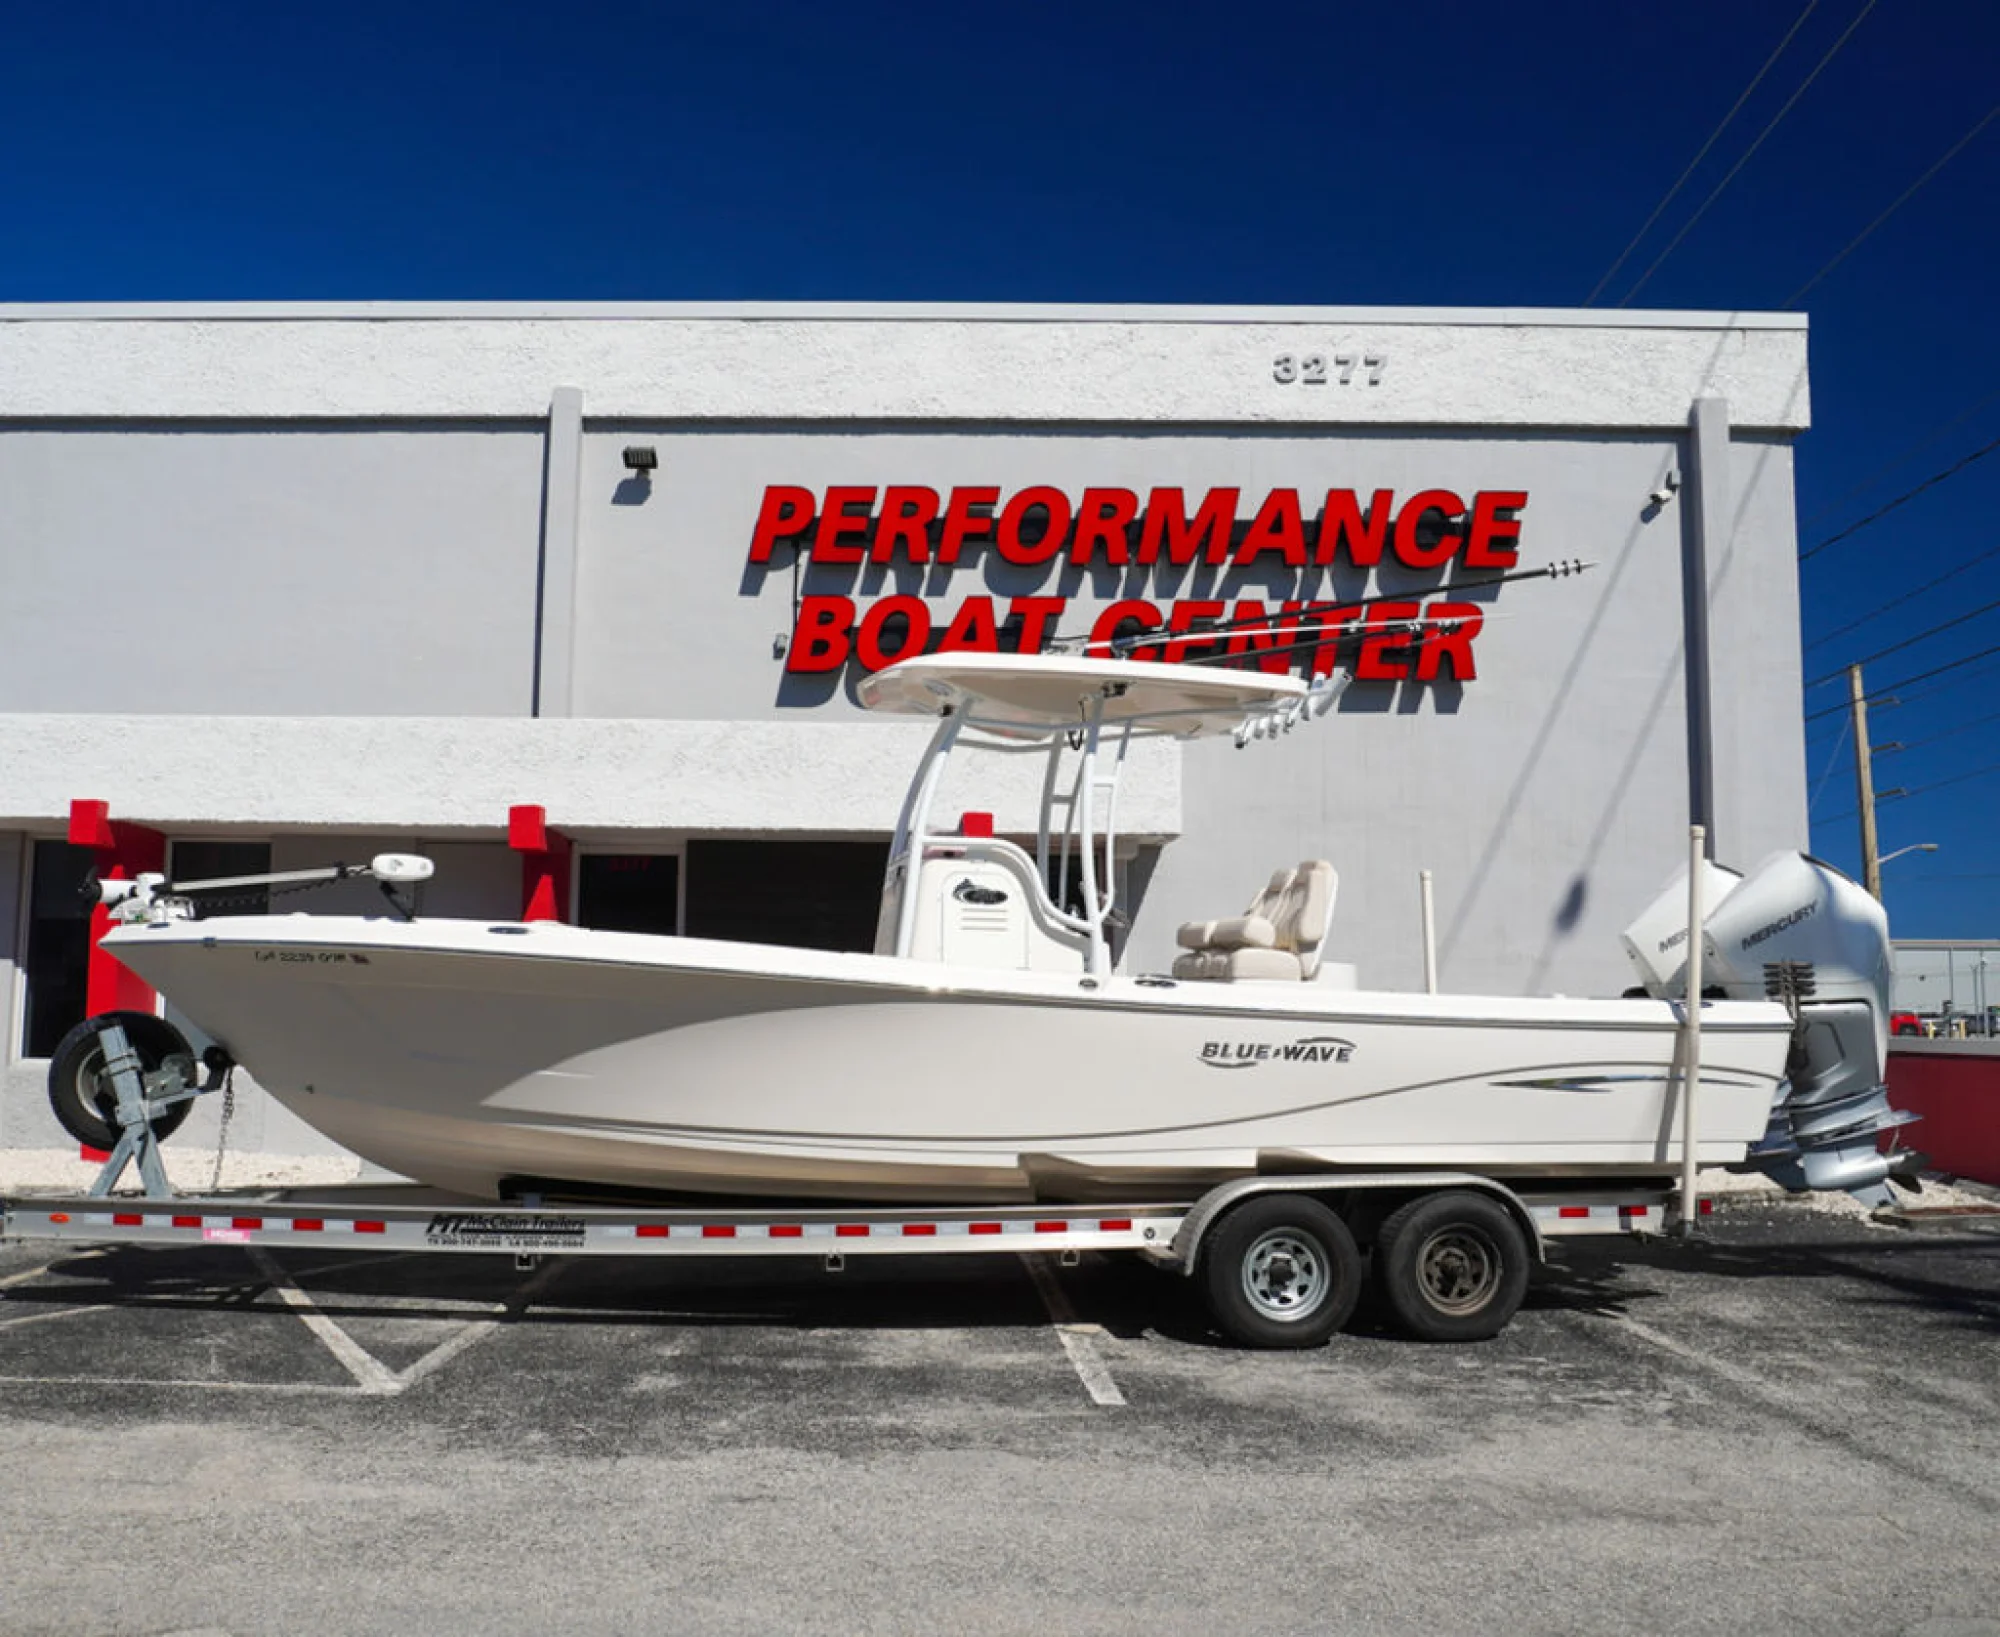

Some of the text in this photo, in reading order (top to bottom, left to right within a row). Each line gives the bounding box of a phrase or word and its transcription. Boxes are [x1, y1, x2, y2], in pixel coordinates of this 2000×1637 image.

[1272, 352, 1388, 386] 3277
[749, 485, 1528, 568] PERFORMANCE
[786, 594, 1484, 681] BOAT CENTER
[1741, 900, 1818, 950] MERCURY
[1202, 1042, 1354, 1063] BLUE WAVE
